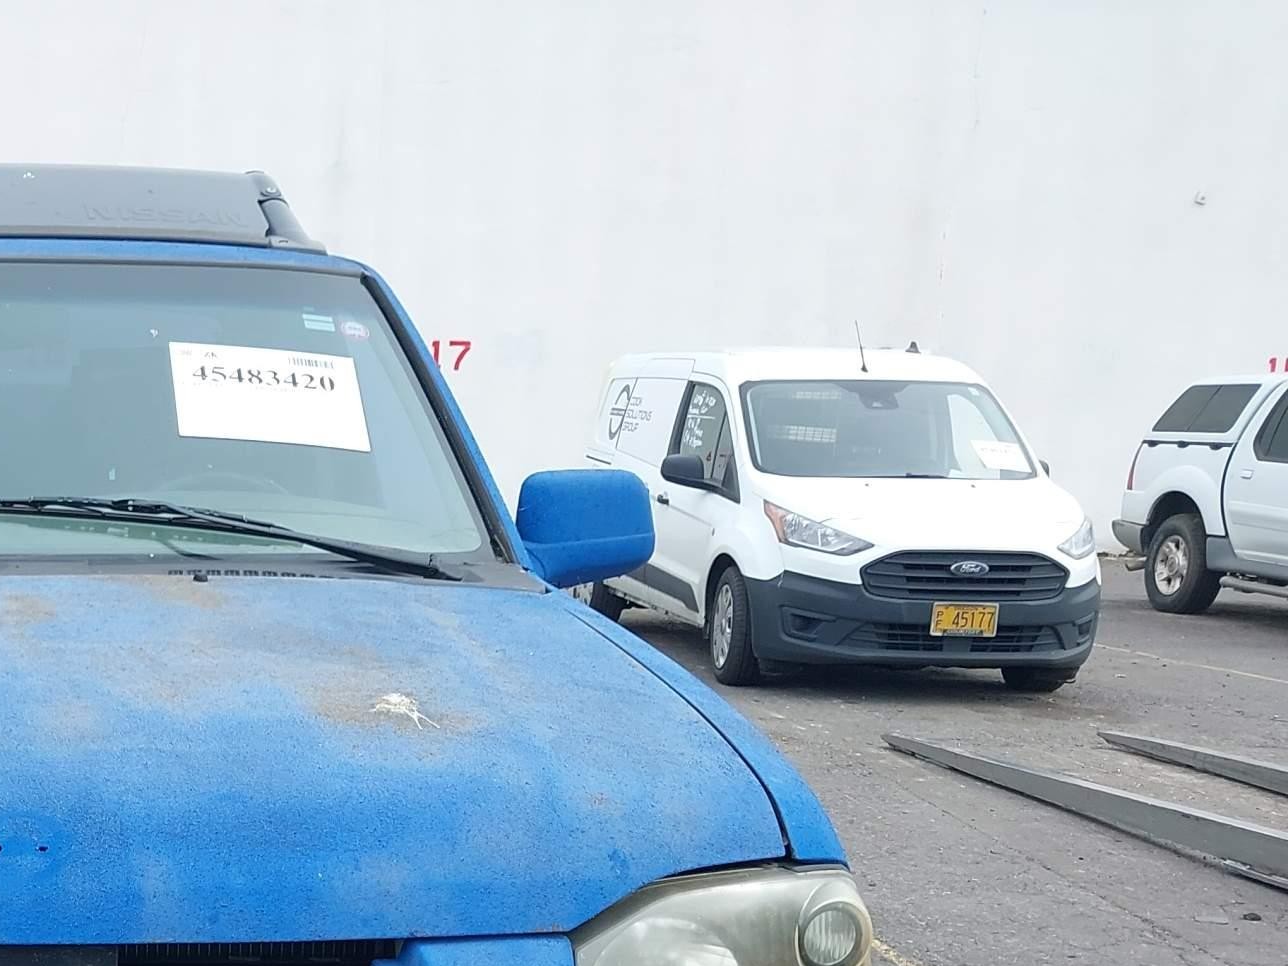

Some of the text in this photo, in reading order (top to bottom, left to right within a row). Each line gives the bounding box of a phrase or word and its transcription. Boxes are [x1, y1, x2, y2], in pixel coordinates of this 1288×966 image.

[83, 204, 249, 227] NISSAN
[431, 340, 471, 370] 17
[1268, 357, 1288, 373] 1
[192, 364, 336, 392] 45483420
[951, 611, 994, 628] 45177
